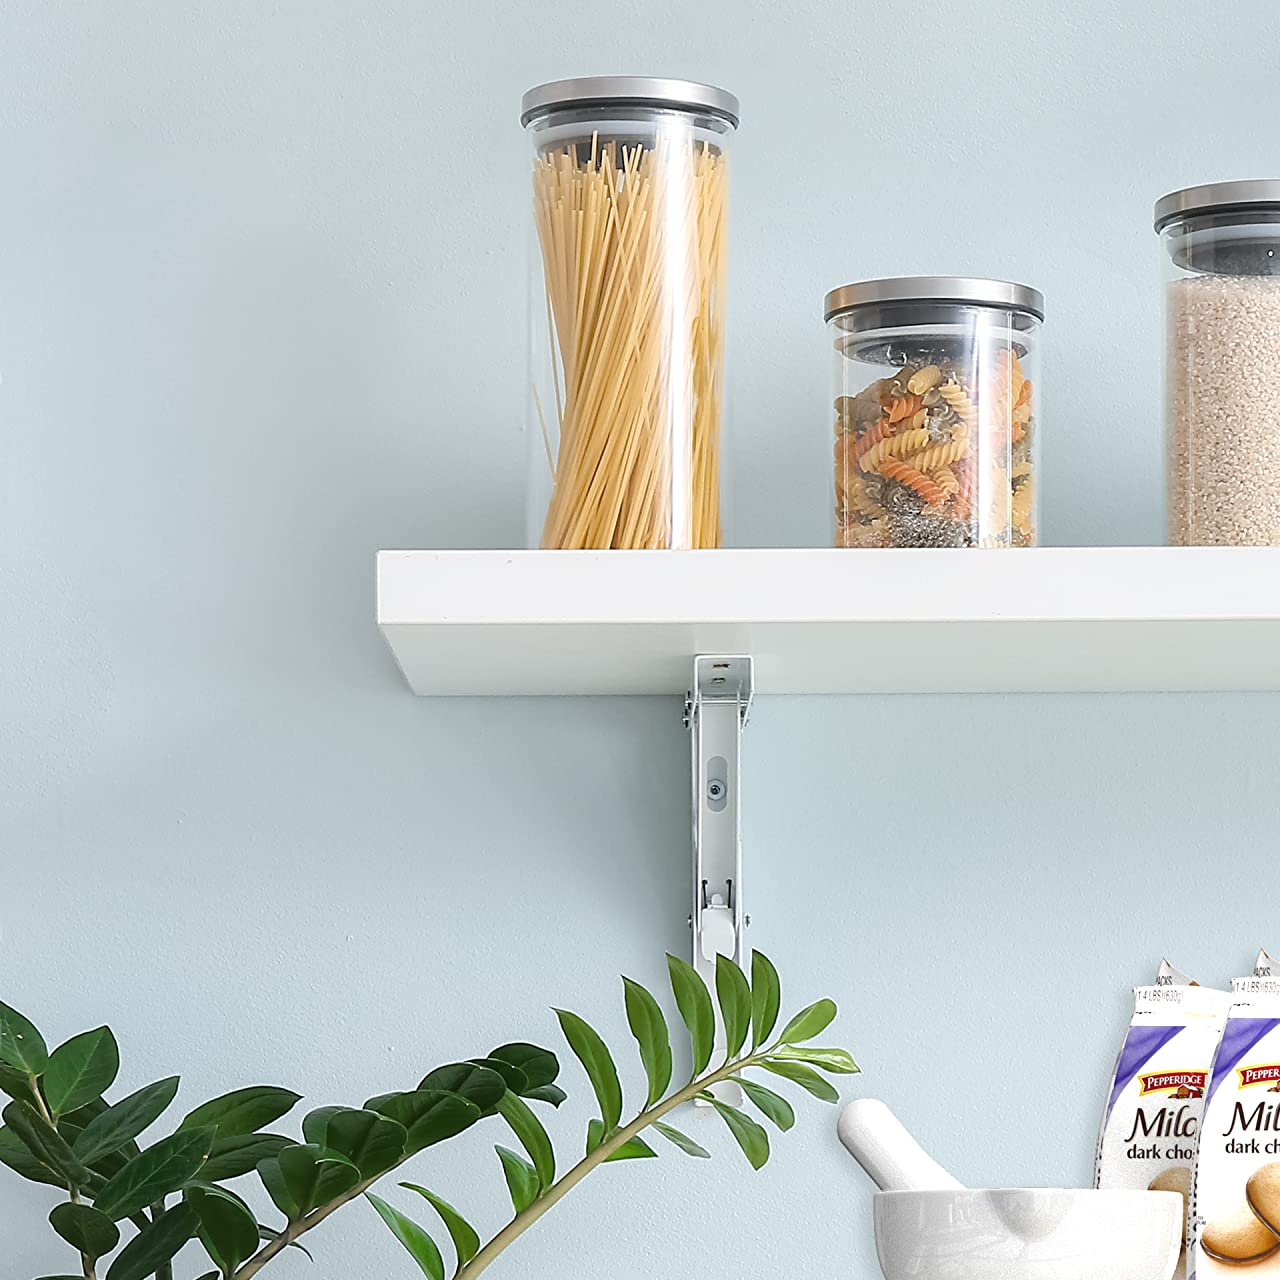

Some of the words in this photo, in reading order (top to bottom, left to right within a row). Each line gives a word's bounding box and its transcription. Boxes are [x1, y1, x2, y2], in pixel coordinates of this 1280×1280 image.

[1147, 1075, 1202, 1089] PEPPERIDGE
[1127, 1144, 1161, 1160] dark
[1225, 1138, 1260, 1154] dark
